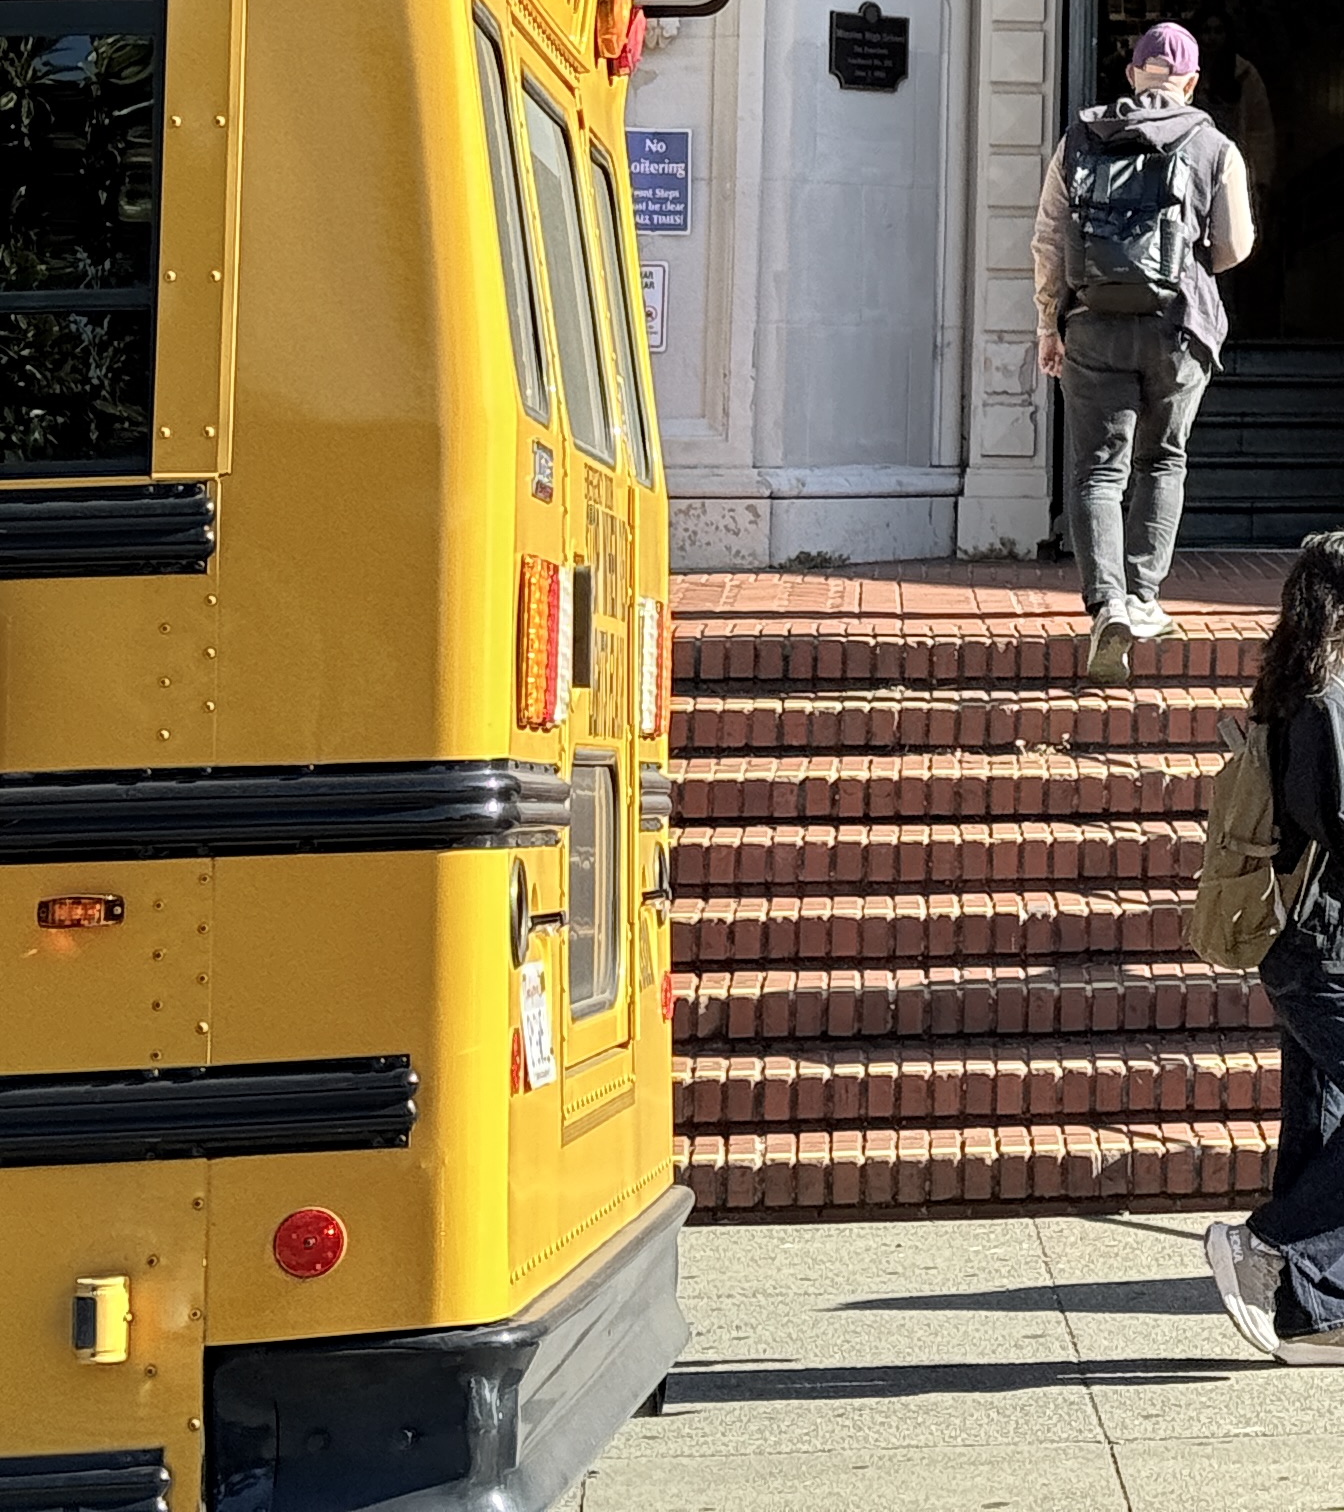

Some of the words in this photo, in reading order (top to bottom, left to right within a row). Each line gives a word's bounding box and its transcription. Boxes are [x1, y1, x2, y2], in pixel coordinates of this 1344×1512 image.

[645, 138, 667, 153] No
[630, 158, 686, 178] oitering
[662, 201, 685, 211] clear
